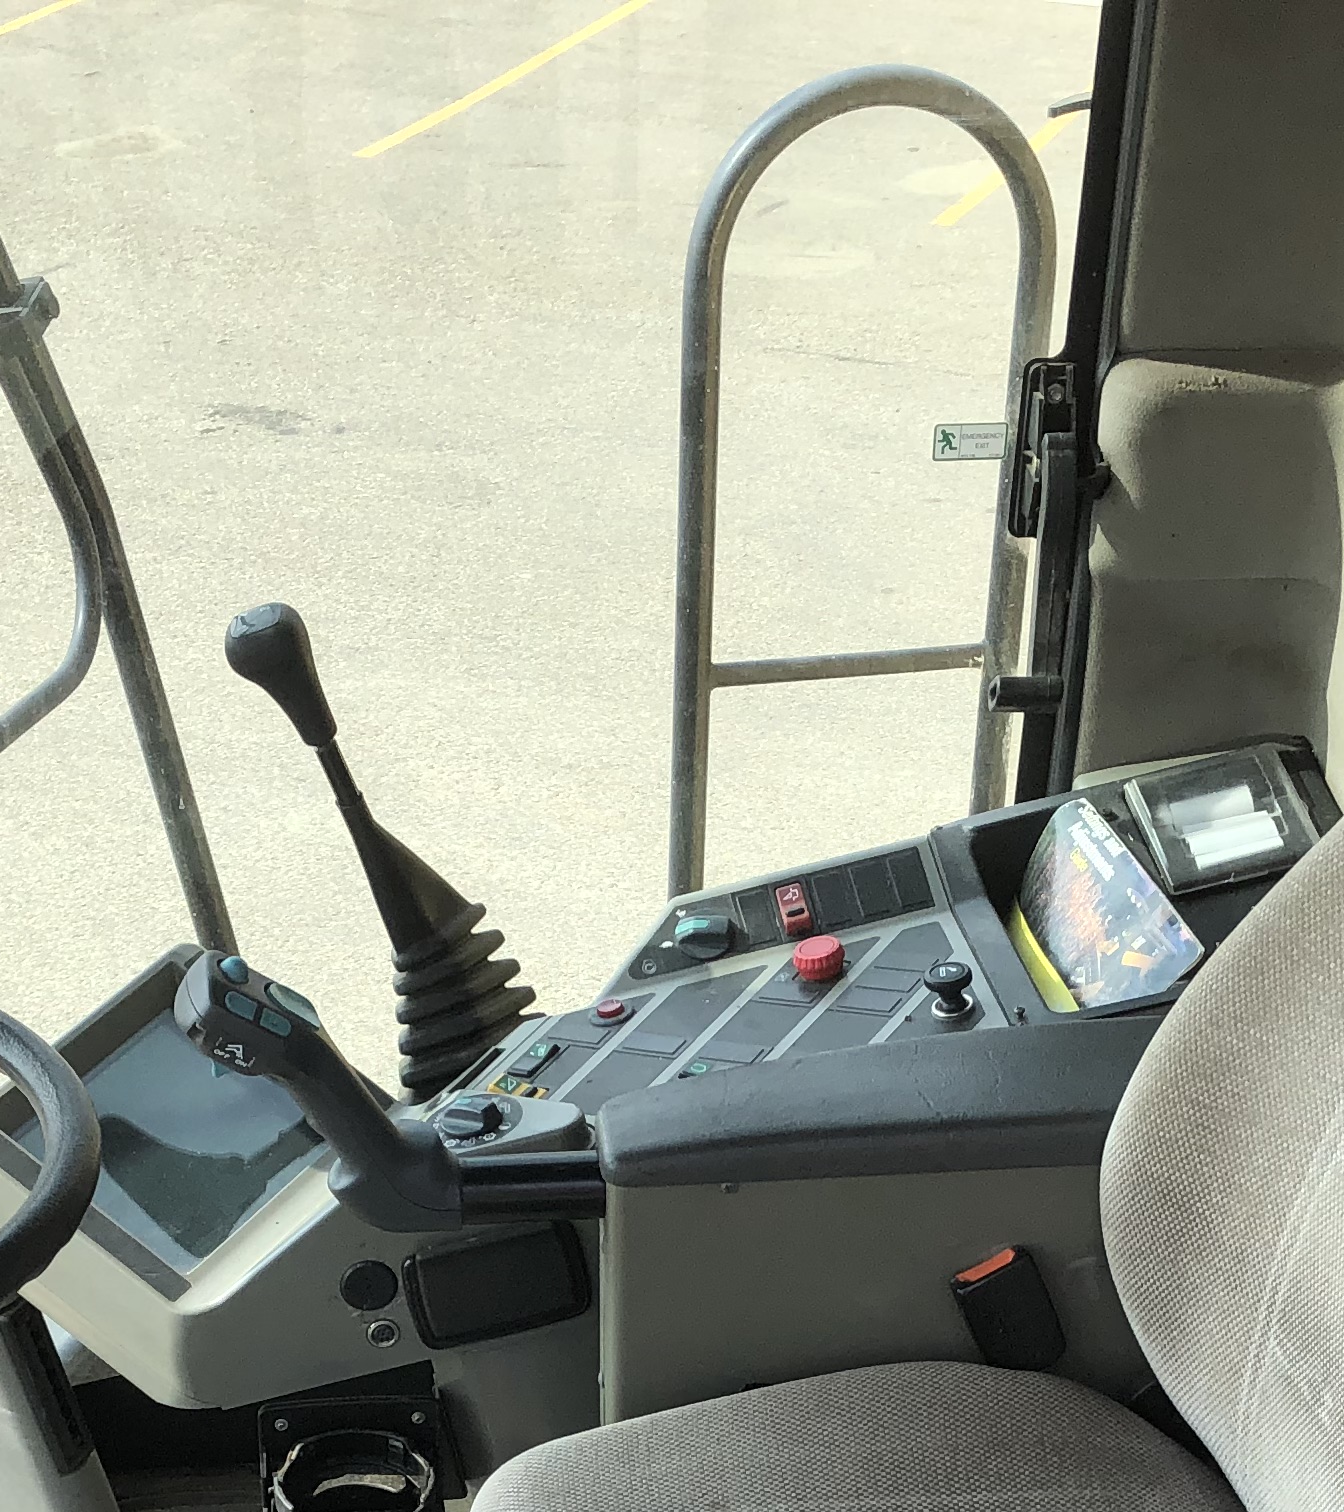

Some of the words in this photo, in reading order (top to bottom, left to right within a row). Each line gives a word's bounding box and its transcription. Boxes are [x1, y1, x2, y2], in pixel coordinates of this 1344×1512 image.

[961, 432, 1004, 440] EMERGENCY
[1067, 820, 1115, 882] Adjustments
[1077, 804, 1111, 841] Settings
[1103, 836, 1127, 858] and
